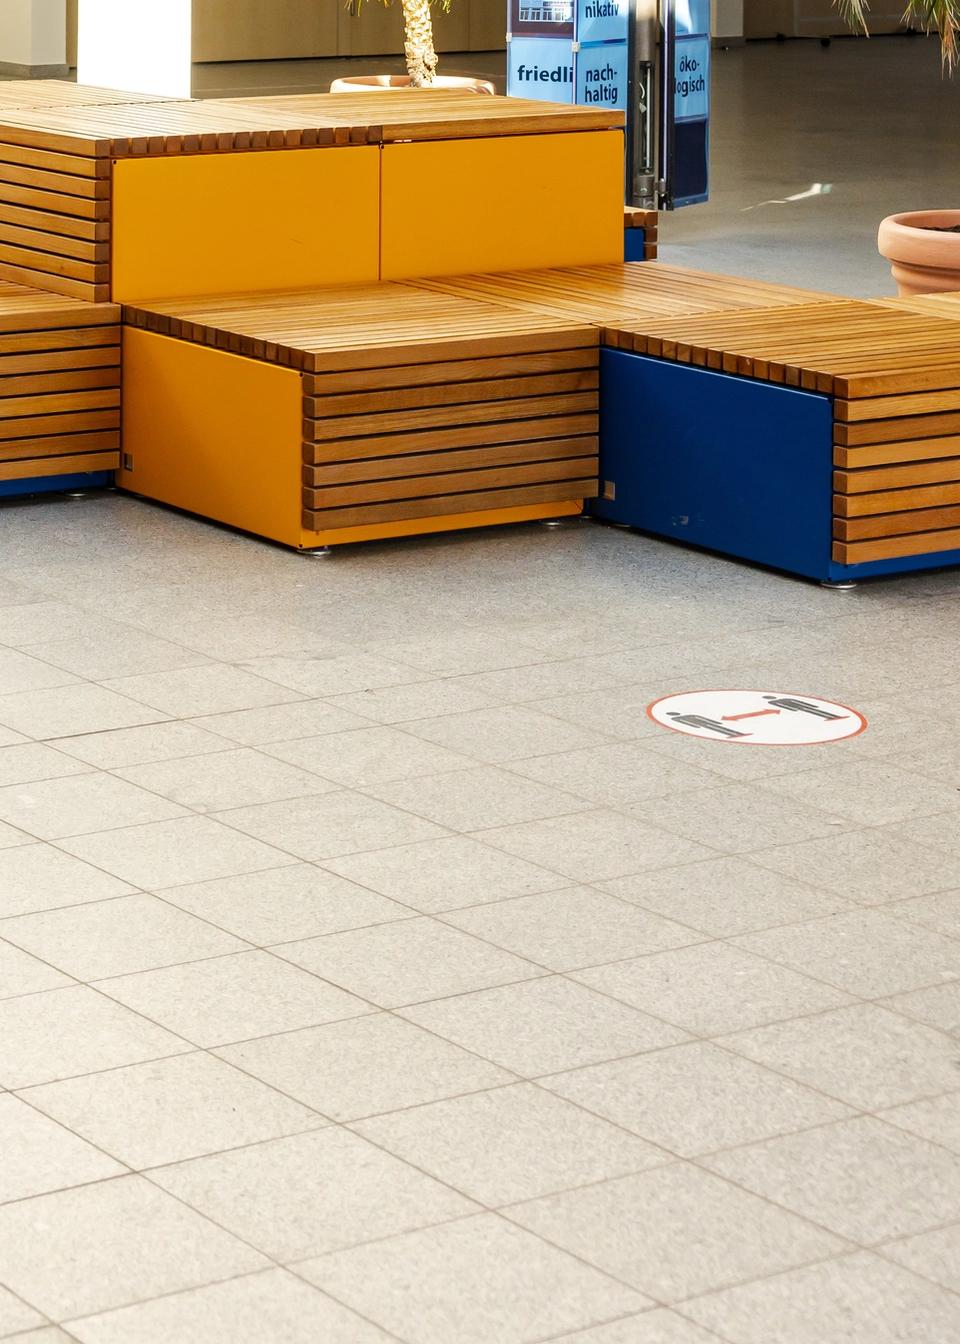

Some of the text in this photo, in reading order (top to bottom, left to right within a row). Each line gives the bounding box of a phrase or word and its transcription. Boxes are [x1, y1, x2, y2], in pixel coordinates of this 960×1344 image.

[585, 1, 619, 18] nikativ
[586, 63, 617, 82] nach-
[679, 56, 700, 72] öko-
[584, 85, 618, 105] haltig
